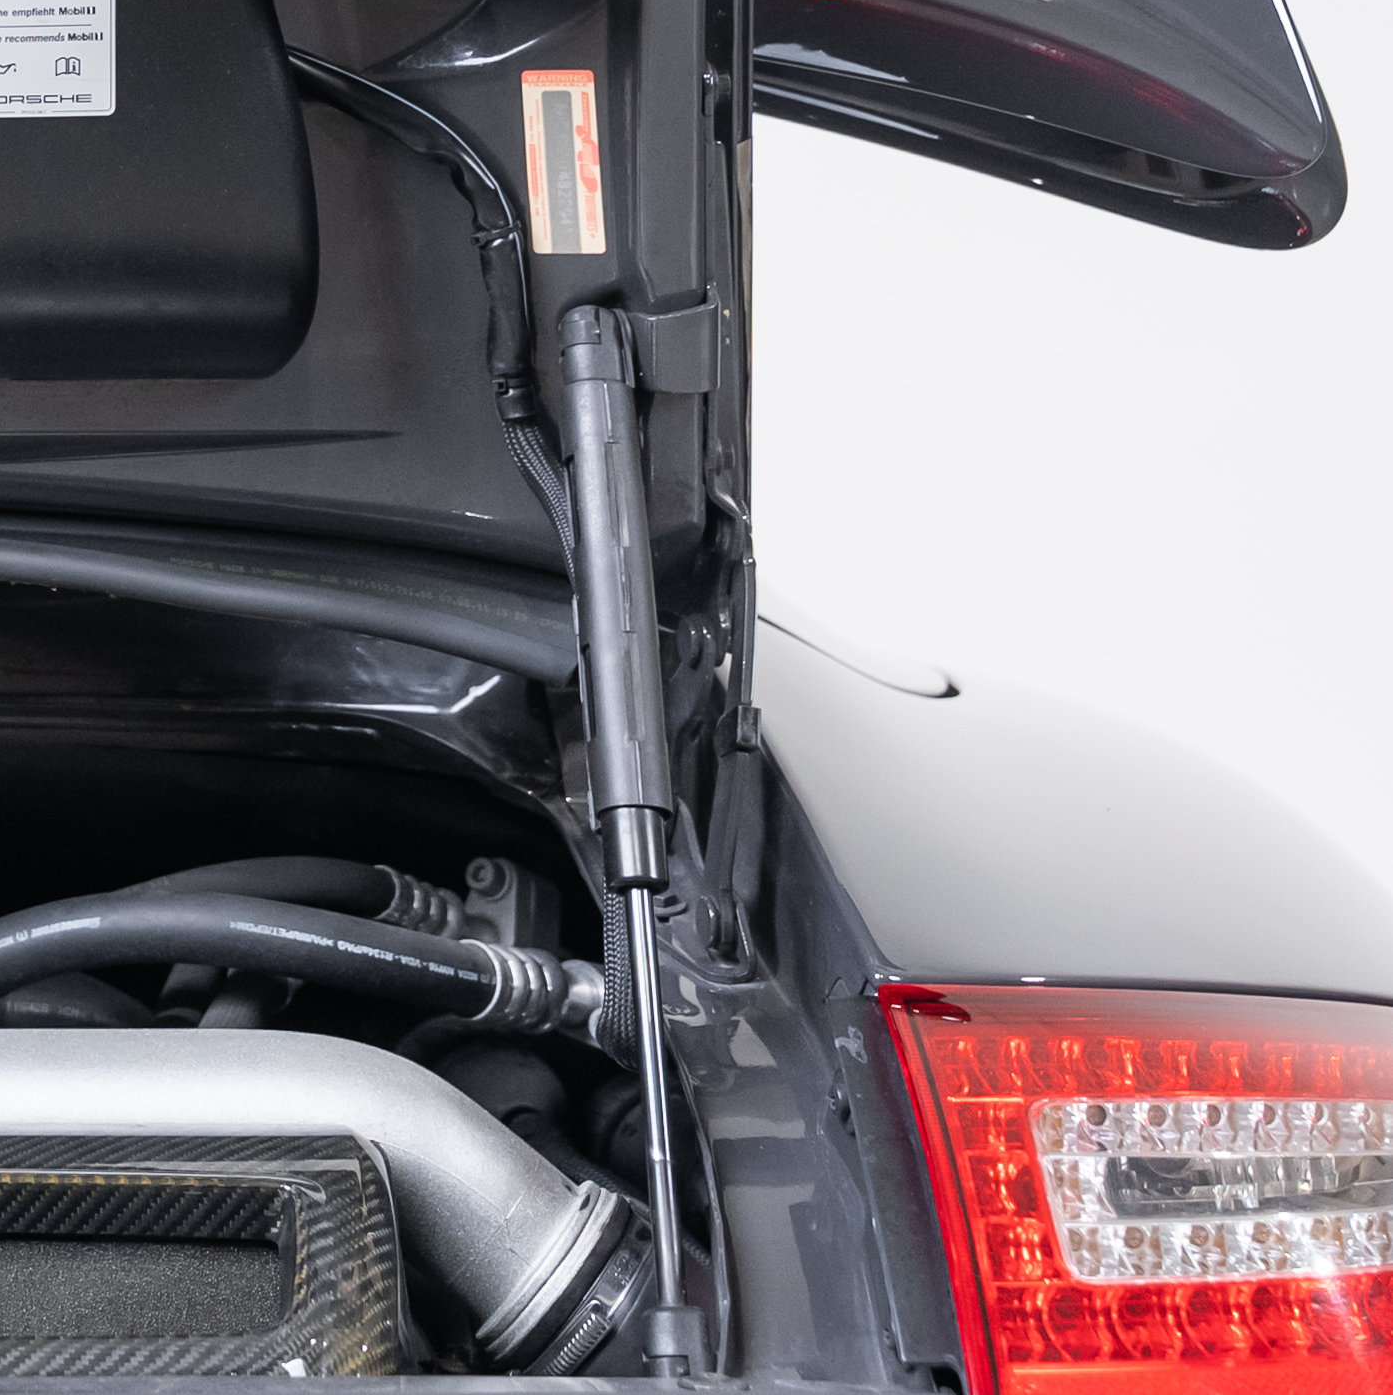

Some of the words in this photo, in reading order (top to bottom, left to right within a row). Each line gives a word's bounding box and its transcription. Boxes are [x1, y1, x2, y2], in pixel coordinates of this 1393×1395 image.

[11, 8, 55, 17] empfiehlt
[59, 7, 85, 16] Mobil
[5, 33, 65, 42] recommends
[67, 32, 93, 41] Mobil
